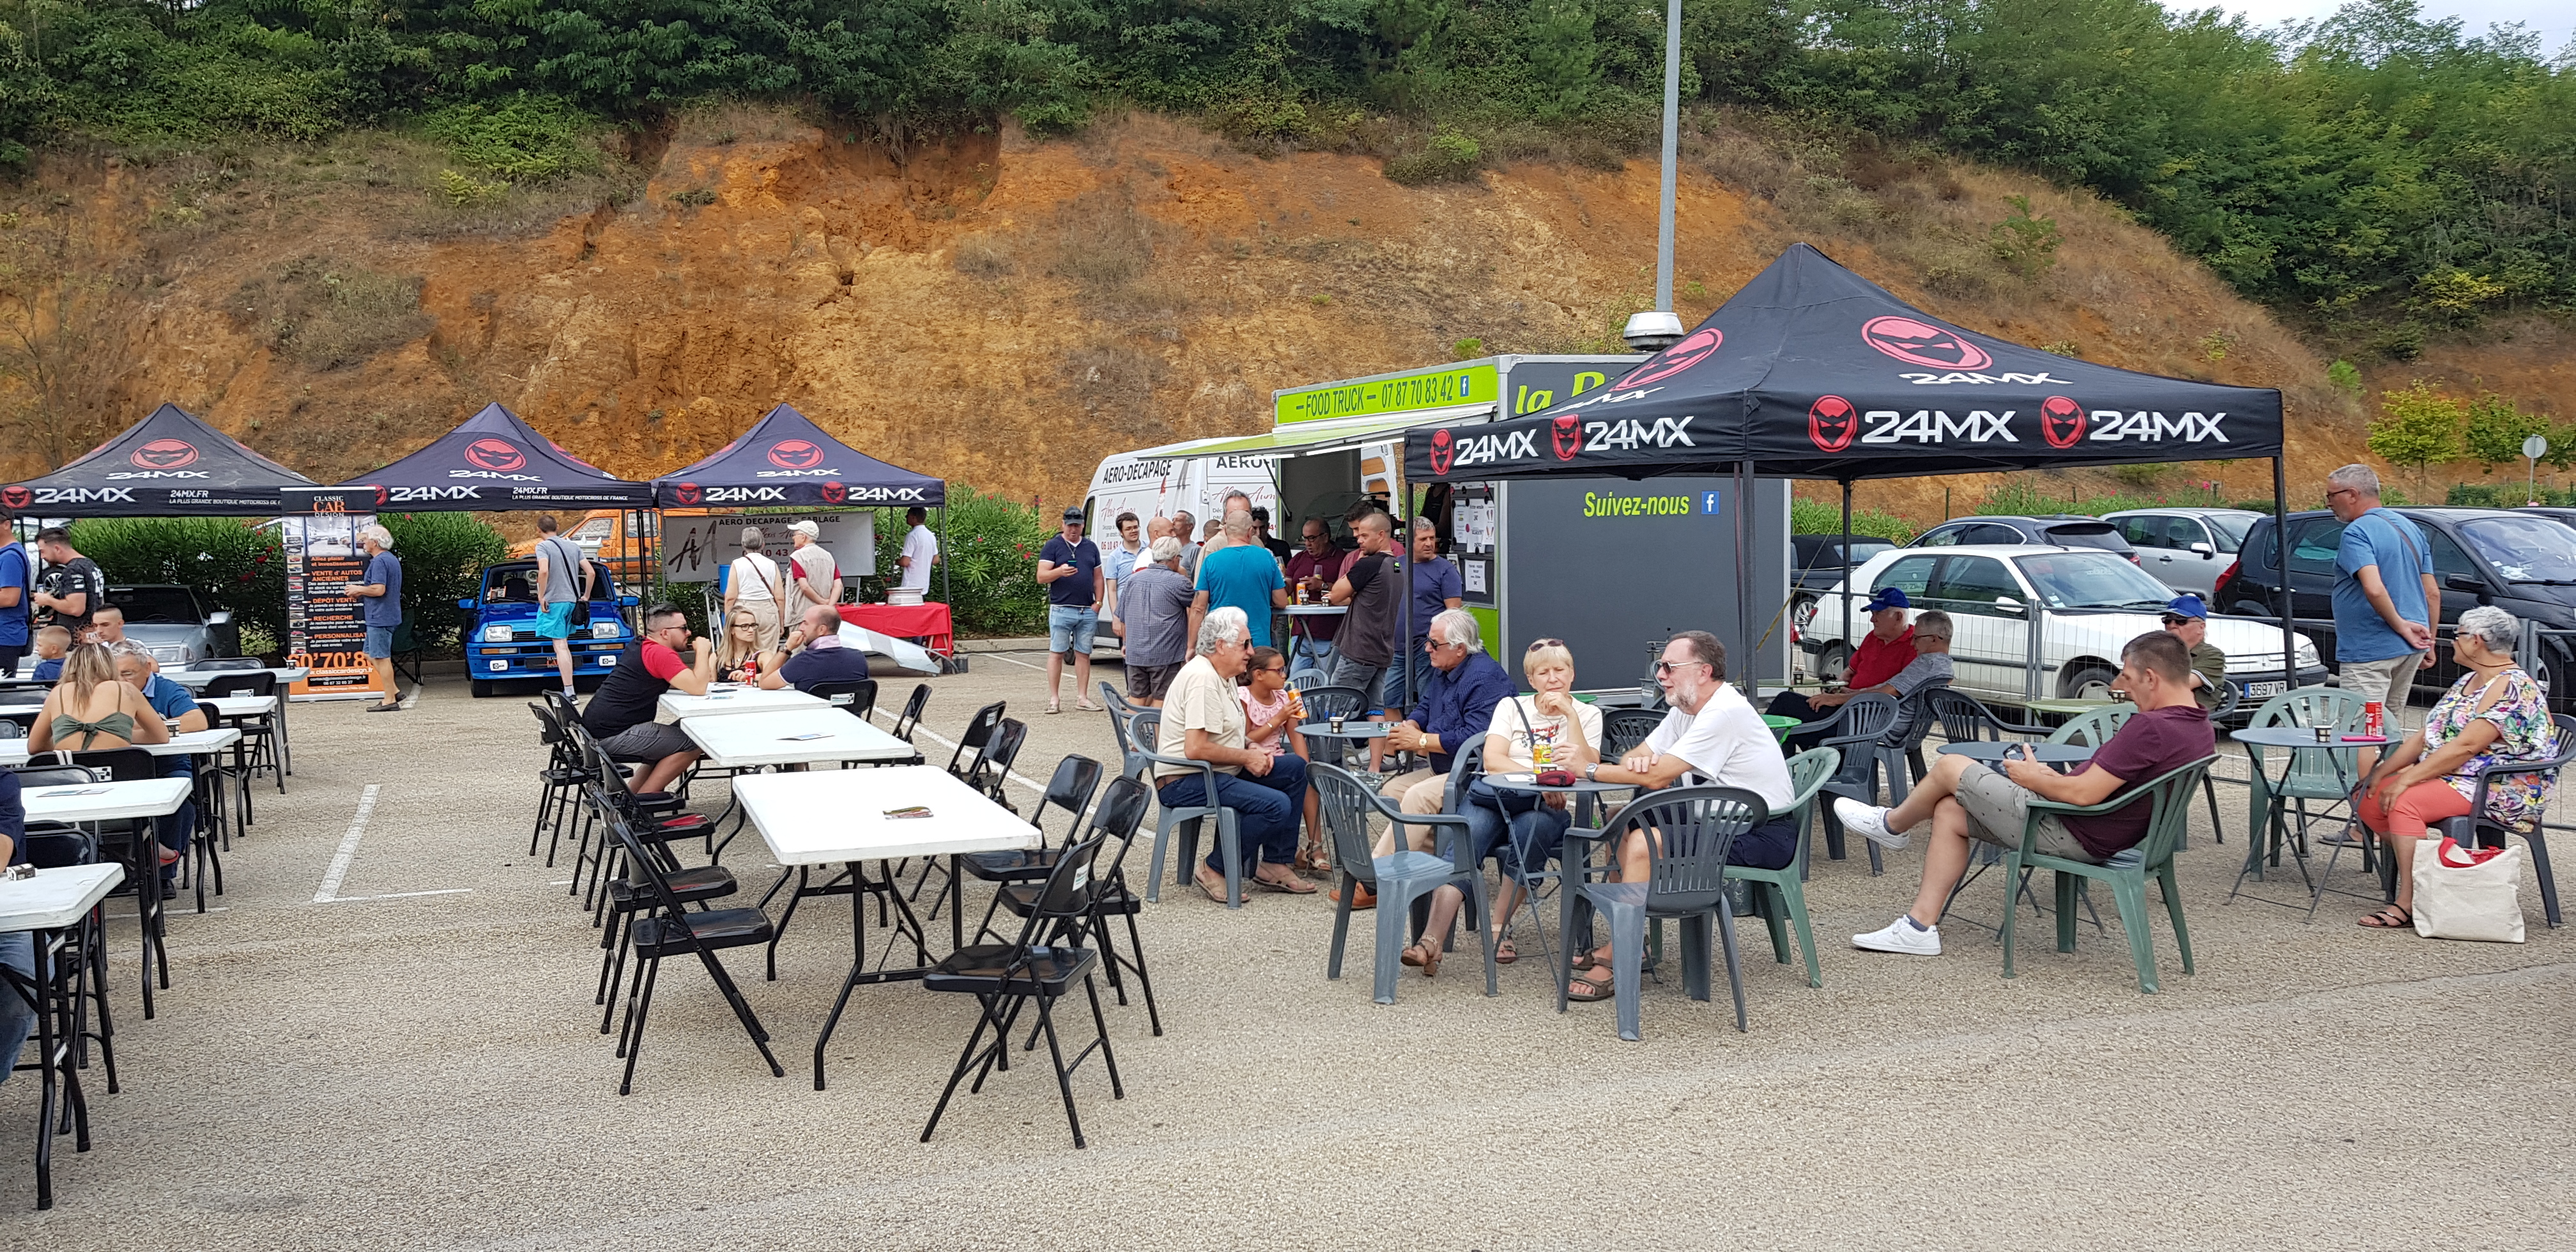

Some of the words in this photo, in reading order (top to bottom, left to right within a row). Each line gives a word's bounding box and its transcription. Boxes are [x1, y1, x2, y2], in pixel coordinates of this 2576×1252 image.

[1899, 372, 2074, 385] 24MX
[1306, 392, 1330, 417] FOOD
[1333, 386, 1365, 413] TRUCK
[1382, 383, 1393, 409] 07
[1396, 381, 1407, 407] 87
[1411, 379, 1422, 405] 70
[1425, 377, 1438, 404] 83
[1440, 375, 1453, 401] 42
[1515, 385, 1553, 415] la
[1584, 416, 1696, 452] 24MX
[1861, 410, 2020, 443] 24MX
[2089, 410, 2230, 443] 24MX
[1453, 429, 1539, 466] 24MX
[106, 471, 210, 480] 24MX
[448, 470, 542, 482] 24MX
[756, 469, 842, 477] 24MX
[1103, 459, 1173, 484] AERO-DECAPAGE
[34, 487, 136, 503] 24MX
[170, 489, 208, 498] 24MX.FR
[390, 485, 482, 501] 24MX
[705, 487, 787, 501] 24MX
[848, 487, 926, 501] 24MX
[313, 501, 345, 512] CAR
[1583, 491, 1690, 517] Suivez-nous
[746, 517, 792, 525] DECAPAGE
[2250, 683, 2273, 696] 3697
[2274, 682, 2285, 694] VR
